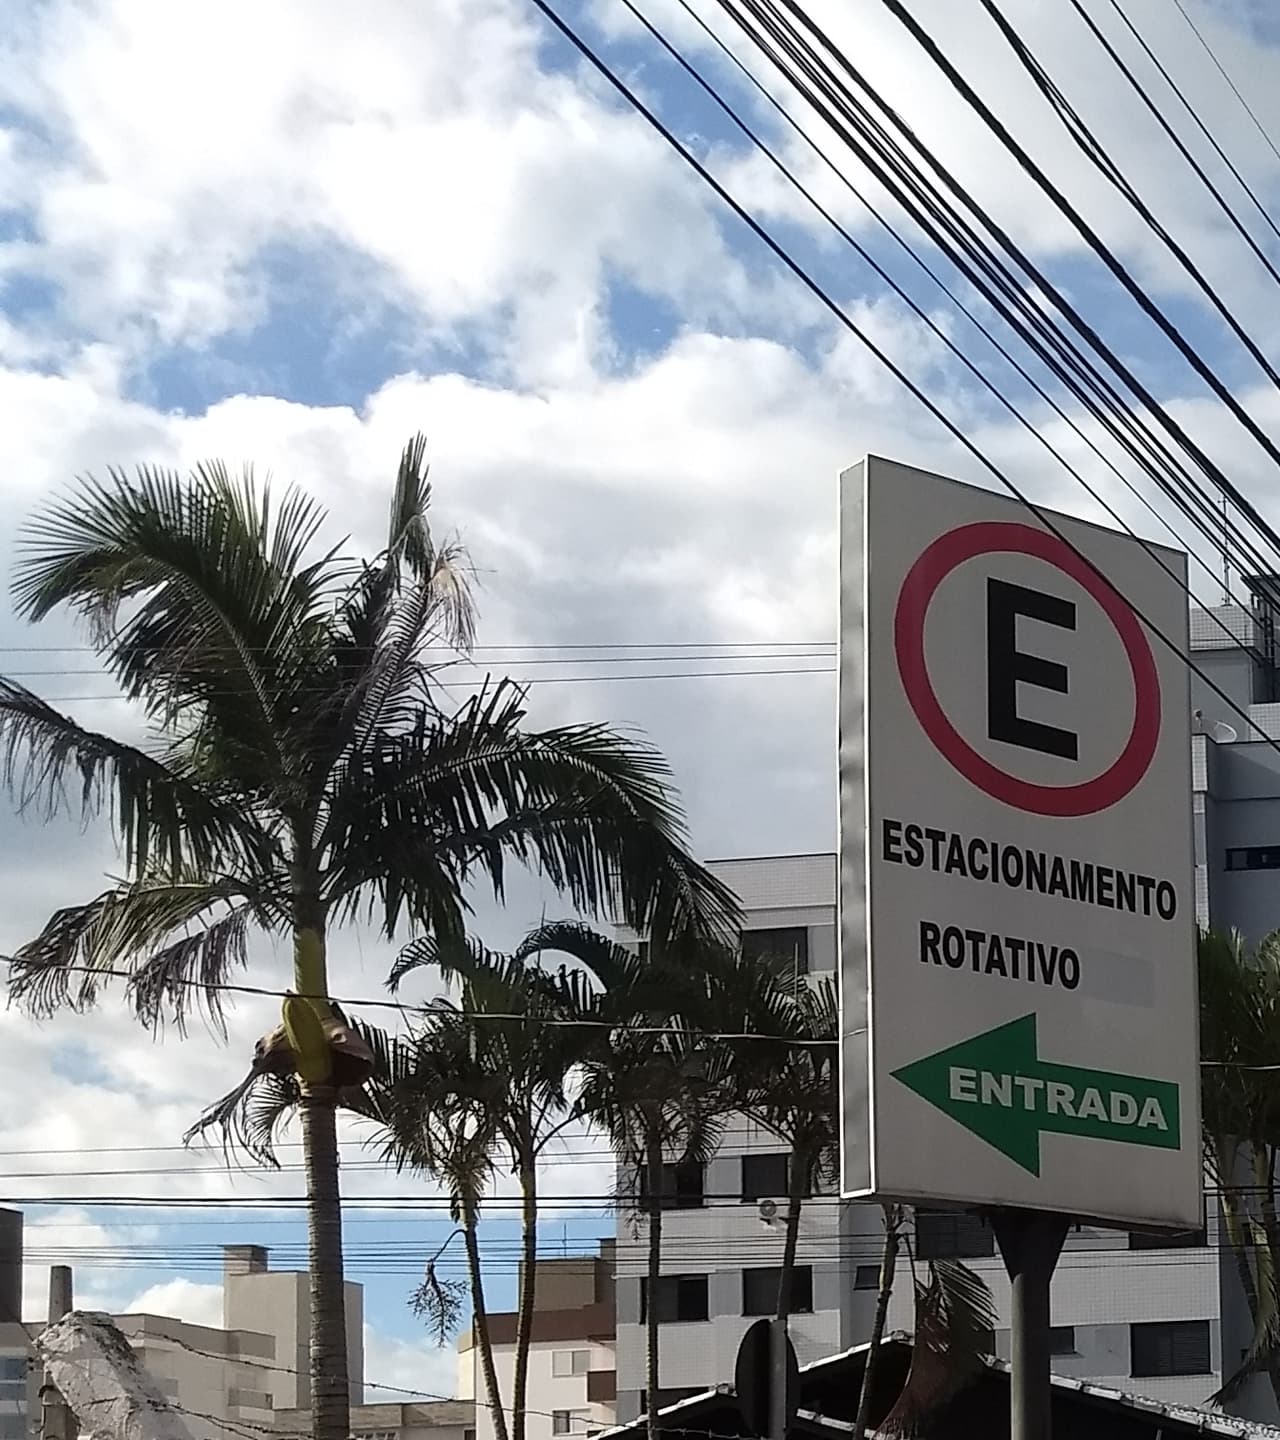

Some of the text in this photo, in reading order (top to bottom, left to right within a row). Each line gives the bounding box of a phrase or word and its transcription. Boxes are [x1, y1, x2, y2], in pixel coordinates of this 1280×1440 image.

[987, 576, 1078, 762] E
[882, 817, 1178, 922] ESTACIONAMENTO
[918, 920, 1082, 991] ROTATIVO
[948, 1065, 1169, 1131] ENTRADA
